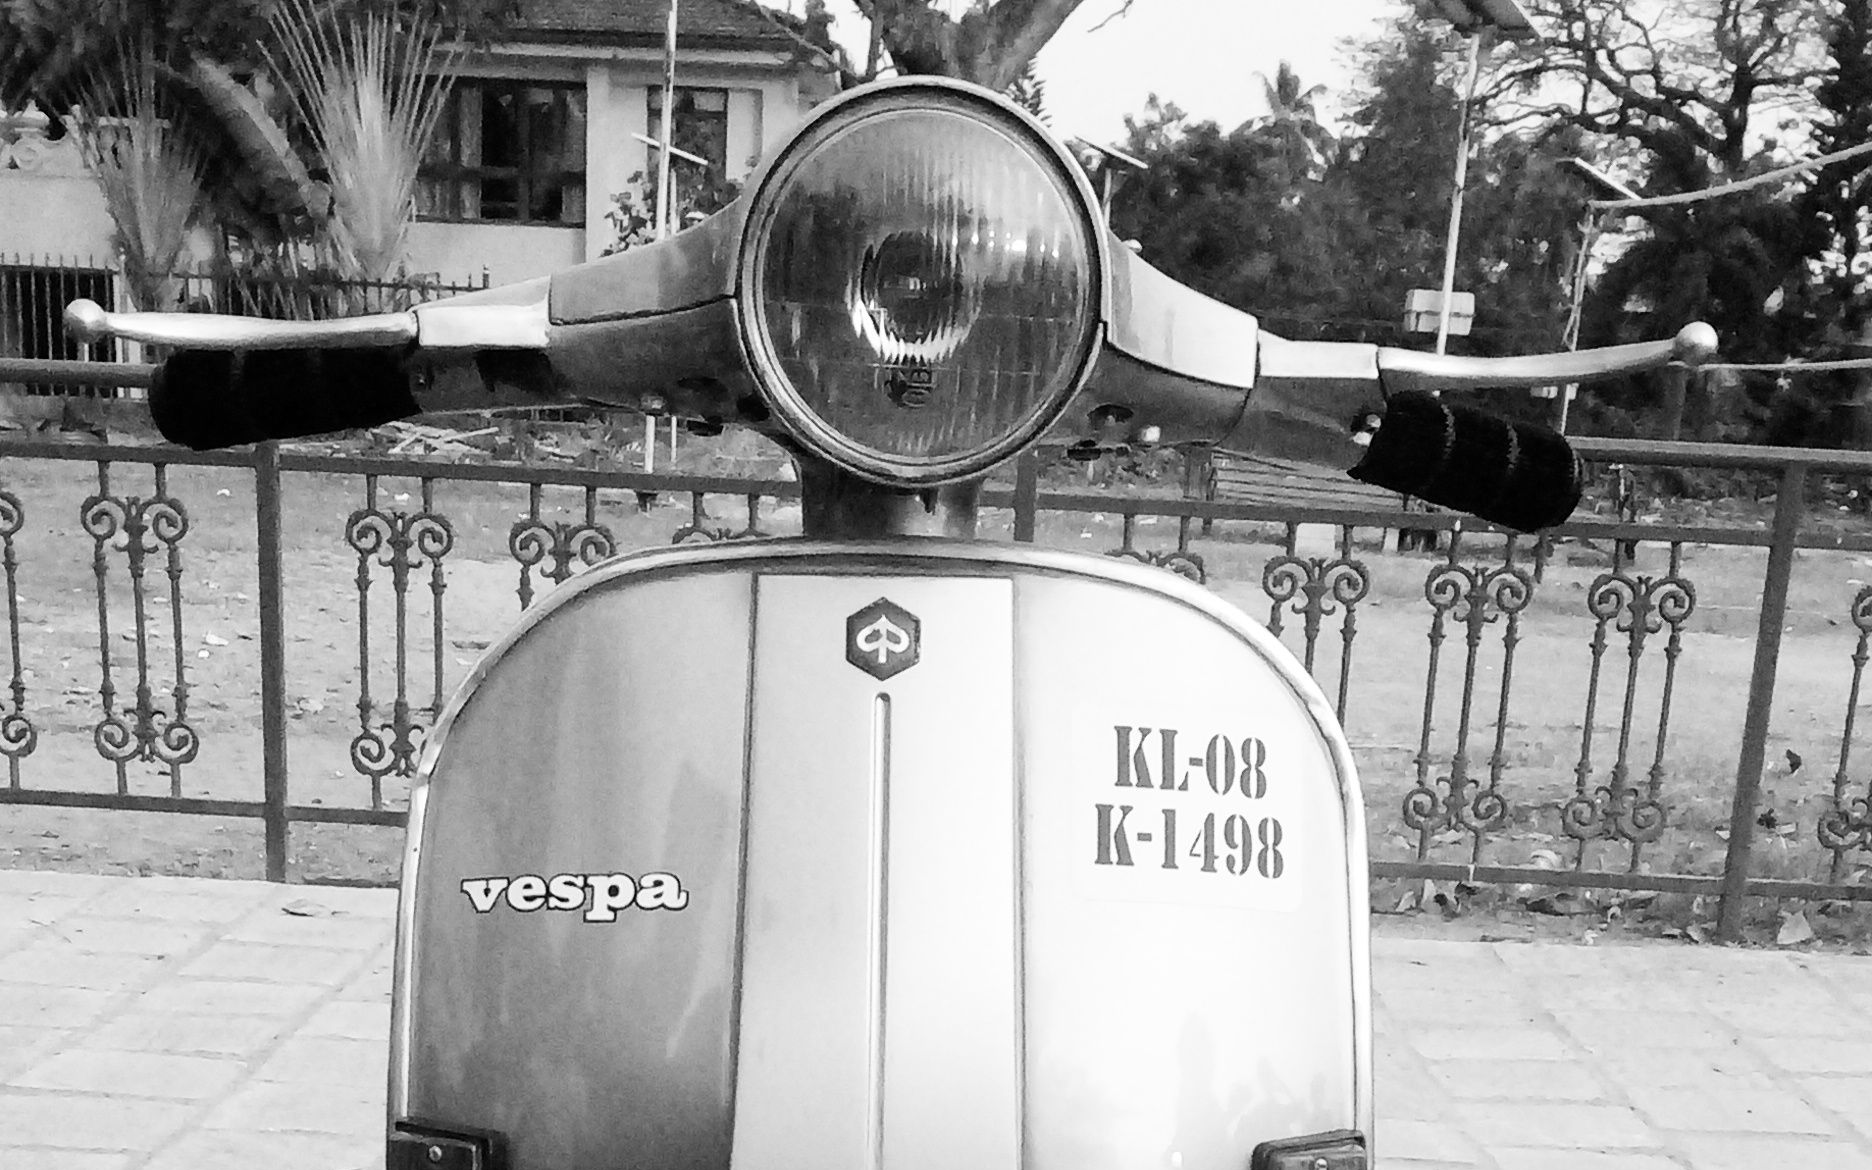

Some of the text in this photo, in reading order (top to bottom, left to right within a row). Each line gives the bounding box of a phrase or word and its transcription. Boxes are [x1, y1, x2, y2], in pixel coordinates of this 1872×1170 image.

[1114, 725, 1267, 799] KL-08
[1095, 803, 1284, 879] K-1498
[460, 872, 689, 923] vespa
